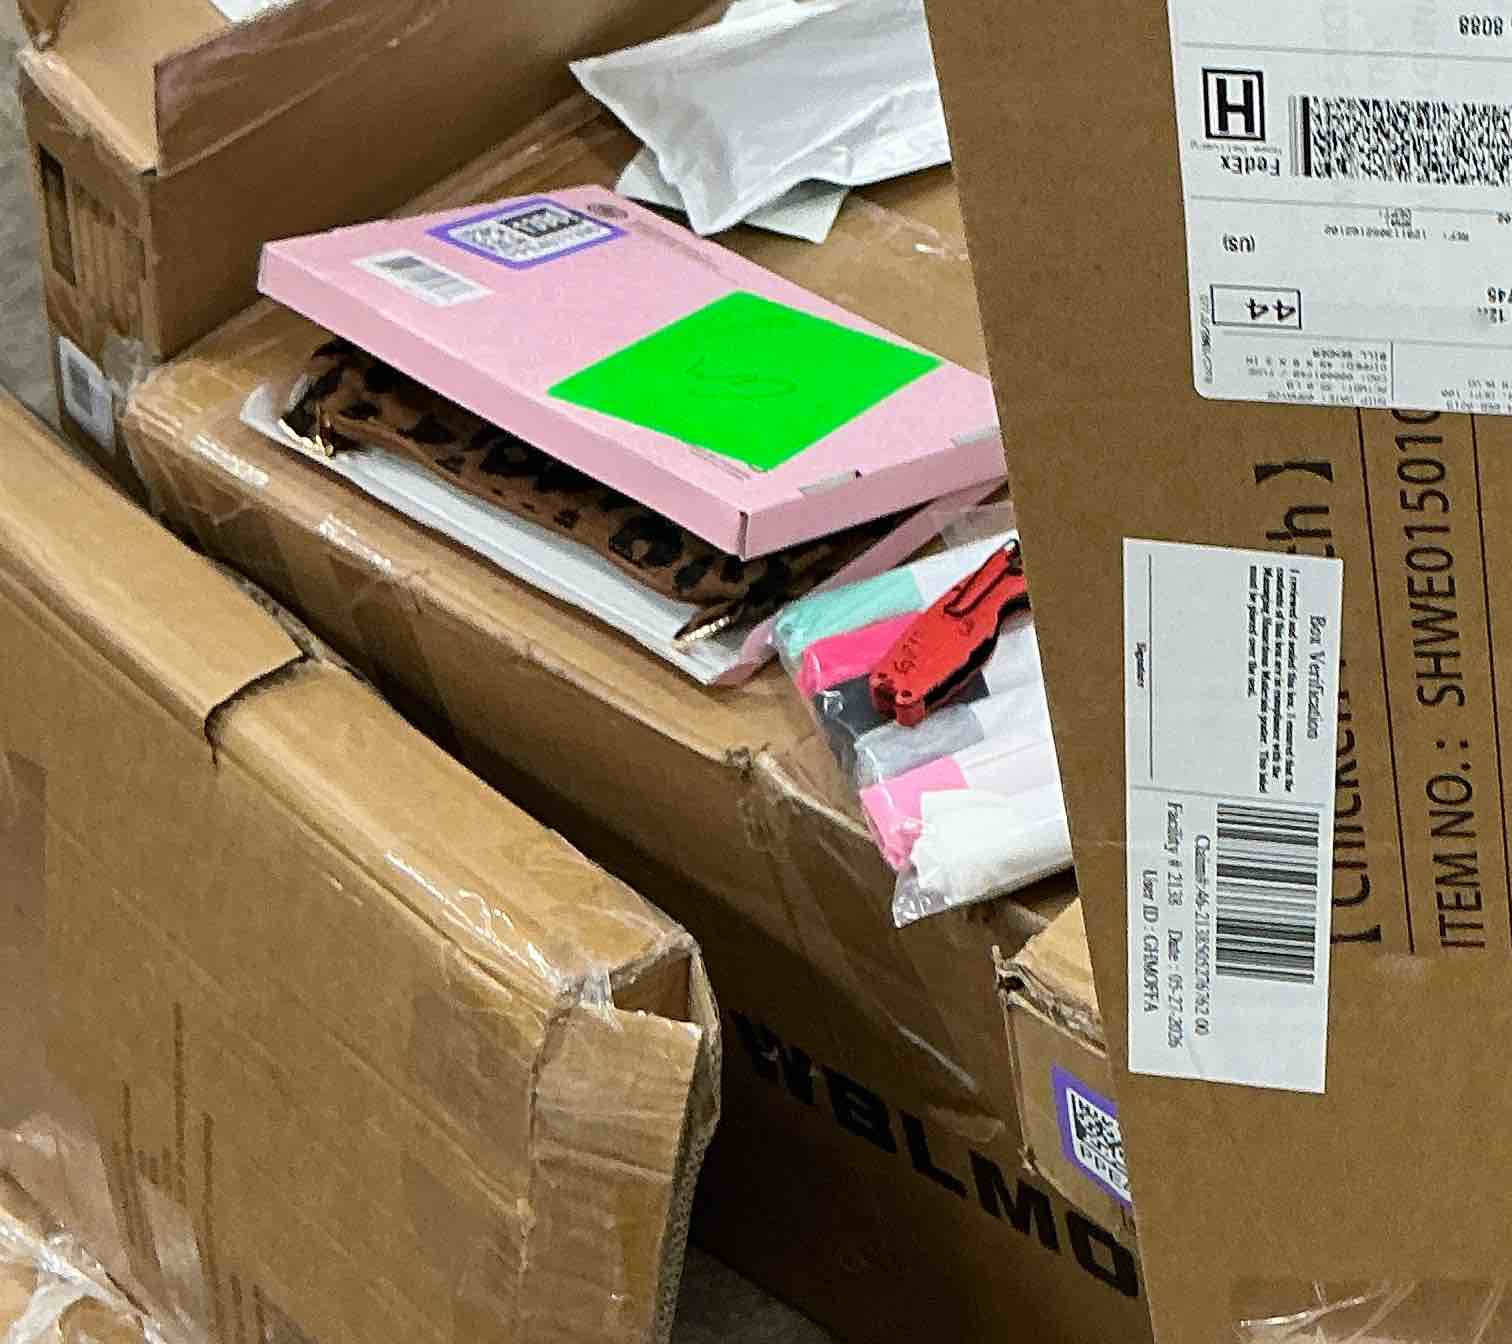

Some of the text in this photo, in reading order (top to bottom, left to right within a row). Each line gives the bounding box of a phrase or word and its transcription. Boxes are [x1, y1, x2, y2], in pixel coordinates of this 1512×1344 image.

[1215, 77, 1256, 135] H
[1219, 155, 1281, 177] FedEx
[1222, 234, 1256, 254] (US)
[1245, 298, 1296, 321] 44
[1307, 615, 1326, 739] Box Verification
[1142, 869, 1158, 901] User
[1142, 904, 1158, 923] ID
[1432, 852, 1486, 949] ITEM
